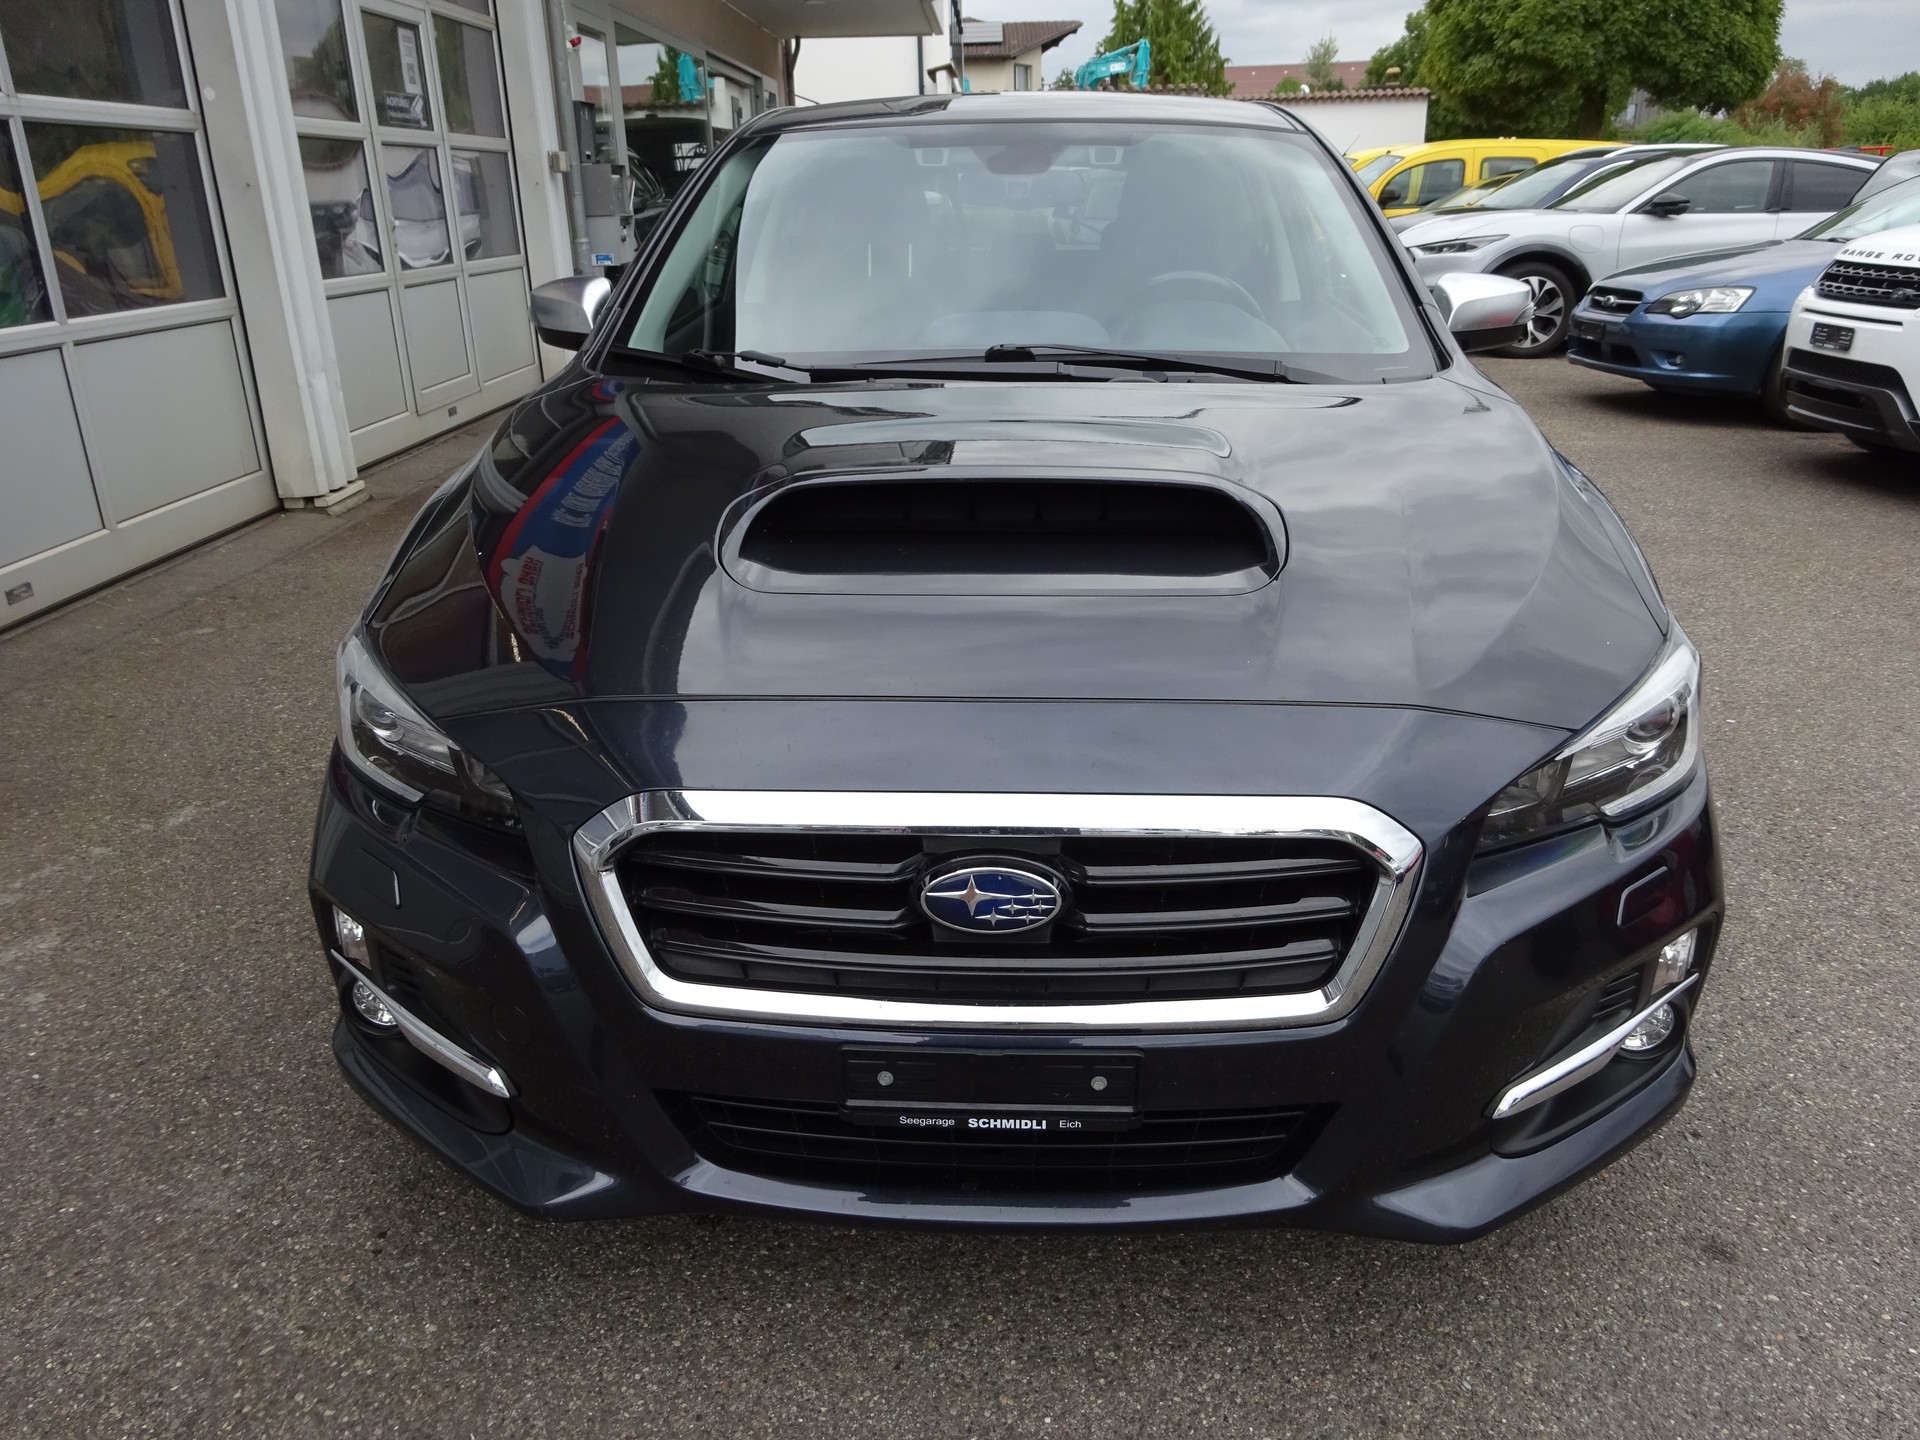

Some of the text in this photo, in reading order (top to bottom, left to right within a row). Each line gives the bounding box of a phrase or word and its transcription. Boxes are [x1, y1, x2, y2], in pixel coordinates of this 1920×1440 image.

[1841, 249, 1885, 259] RANGE
[899, 1116, 1082, 1130] Seegarage SCHMIDLI Eich
